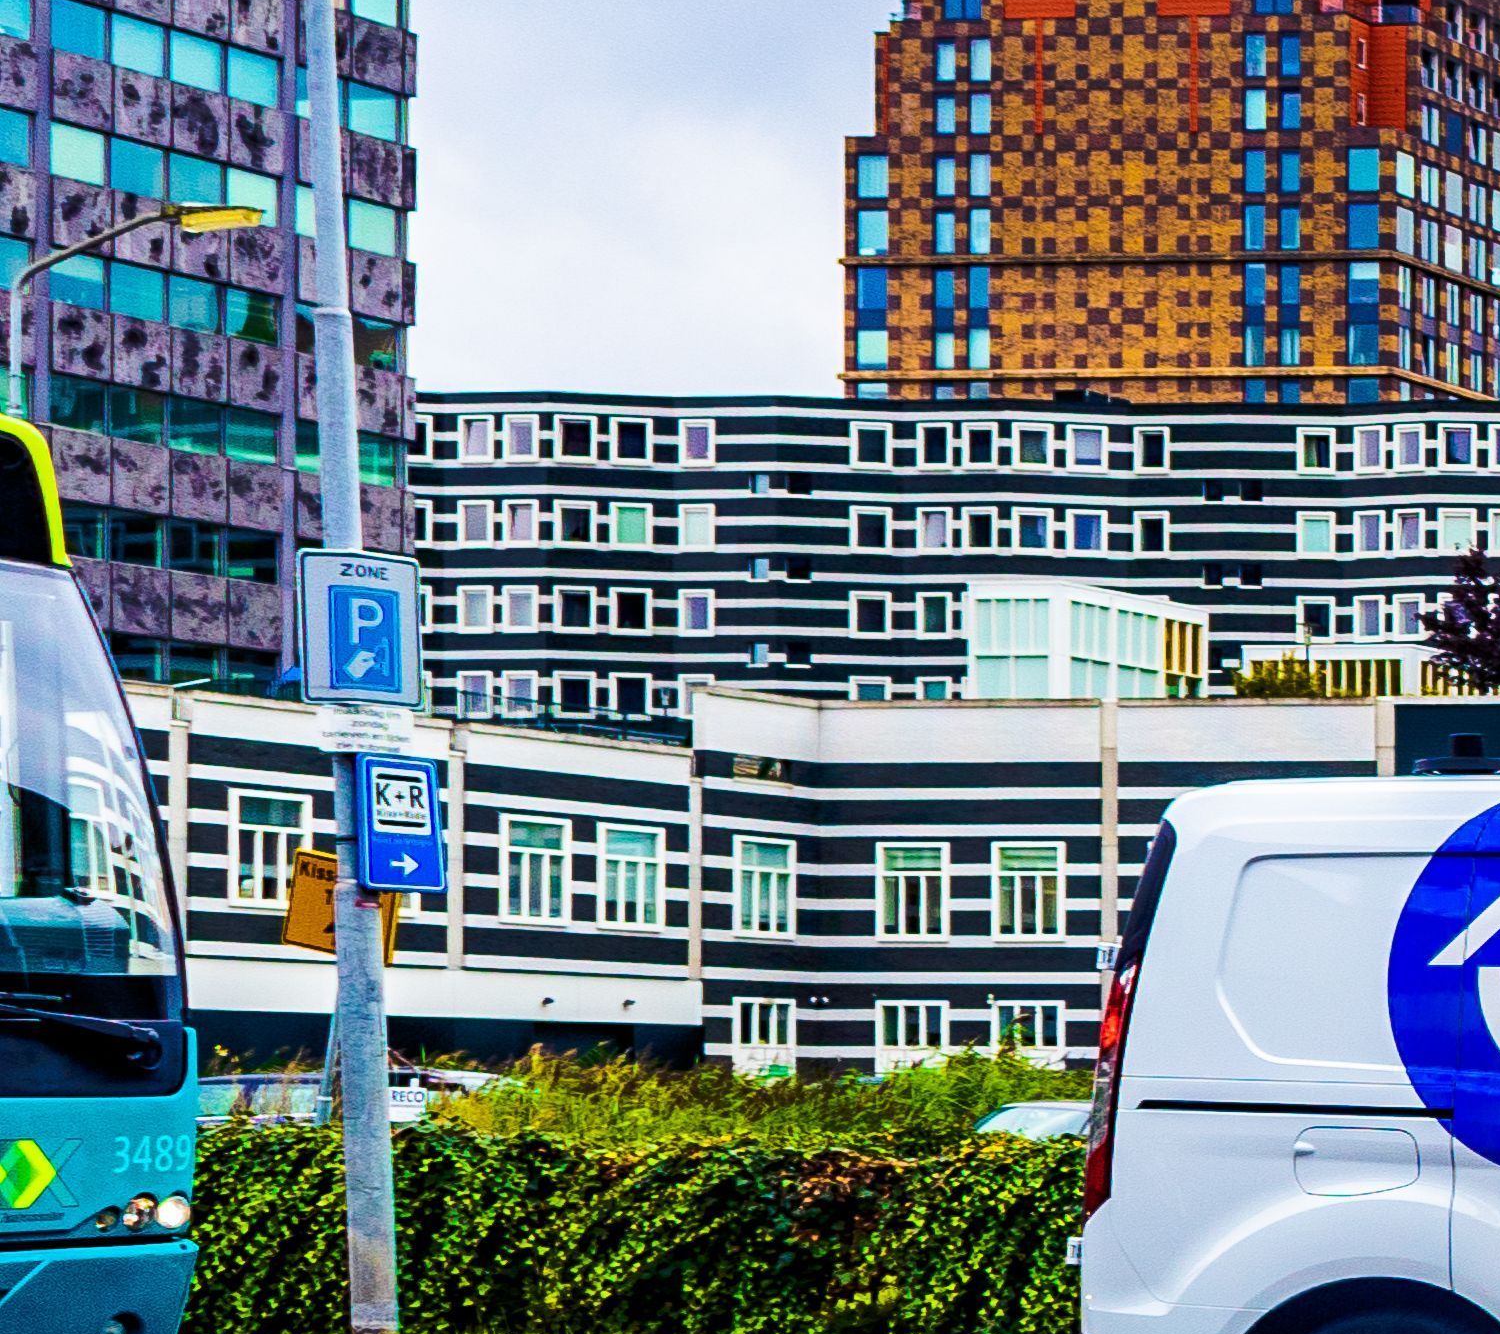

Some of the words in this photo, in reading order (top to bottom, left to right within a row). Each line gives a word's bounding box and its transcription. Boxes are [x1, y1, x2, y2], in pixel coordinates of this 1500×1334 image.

[340, 563, 389, 581] ZONE
[351, 598, 384, 644] P
[113, 1134, 192, 1174] 3489
